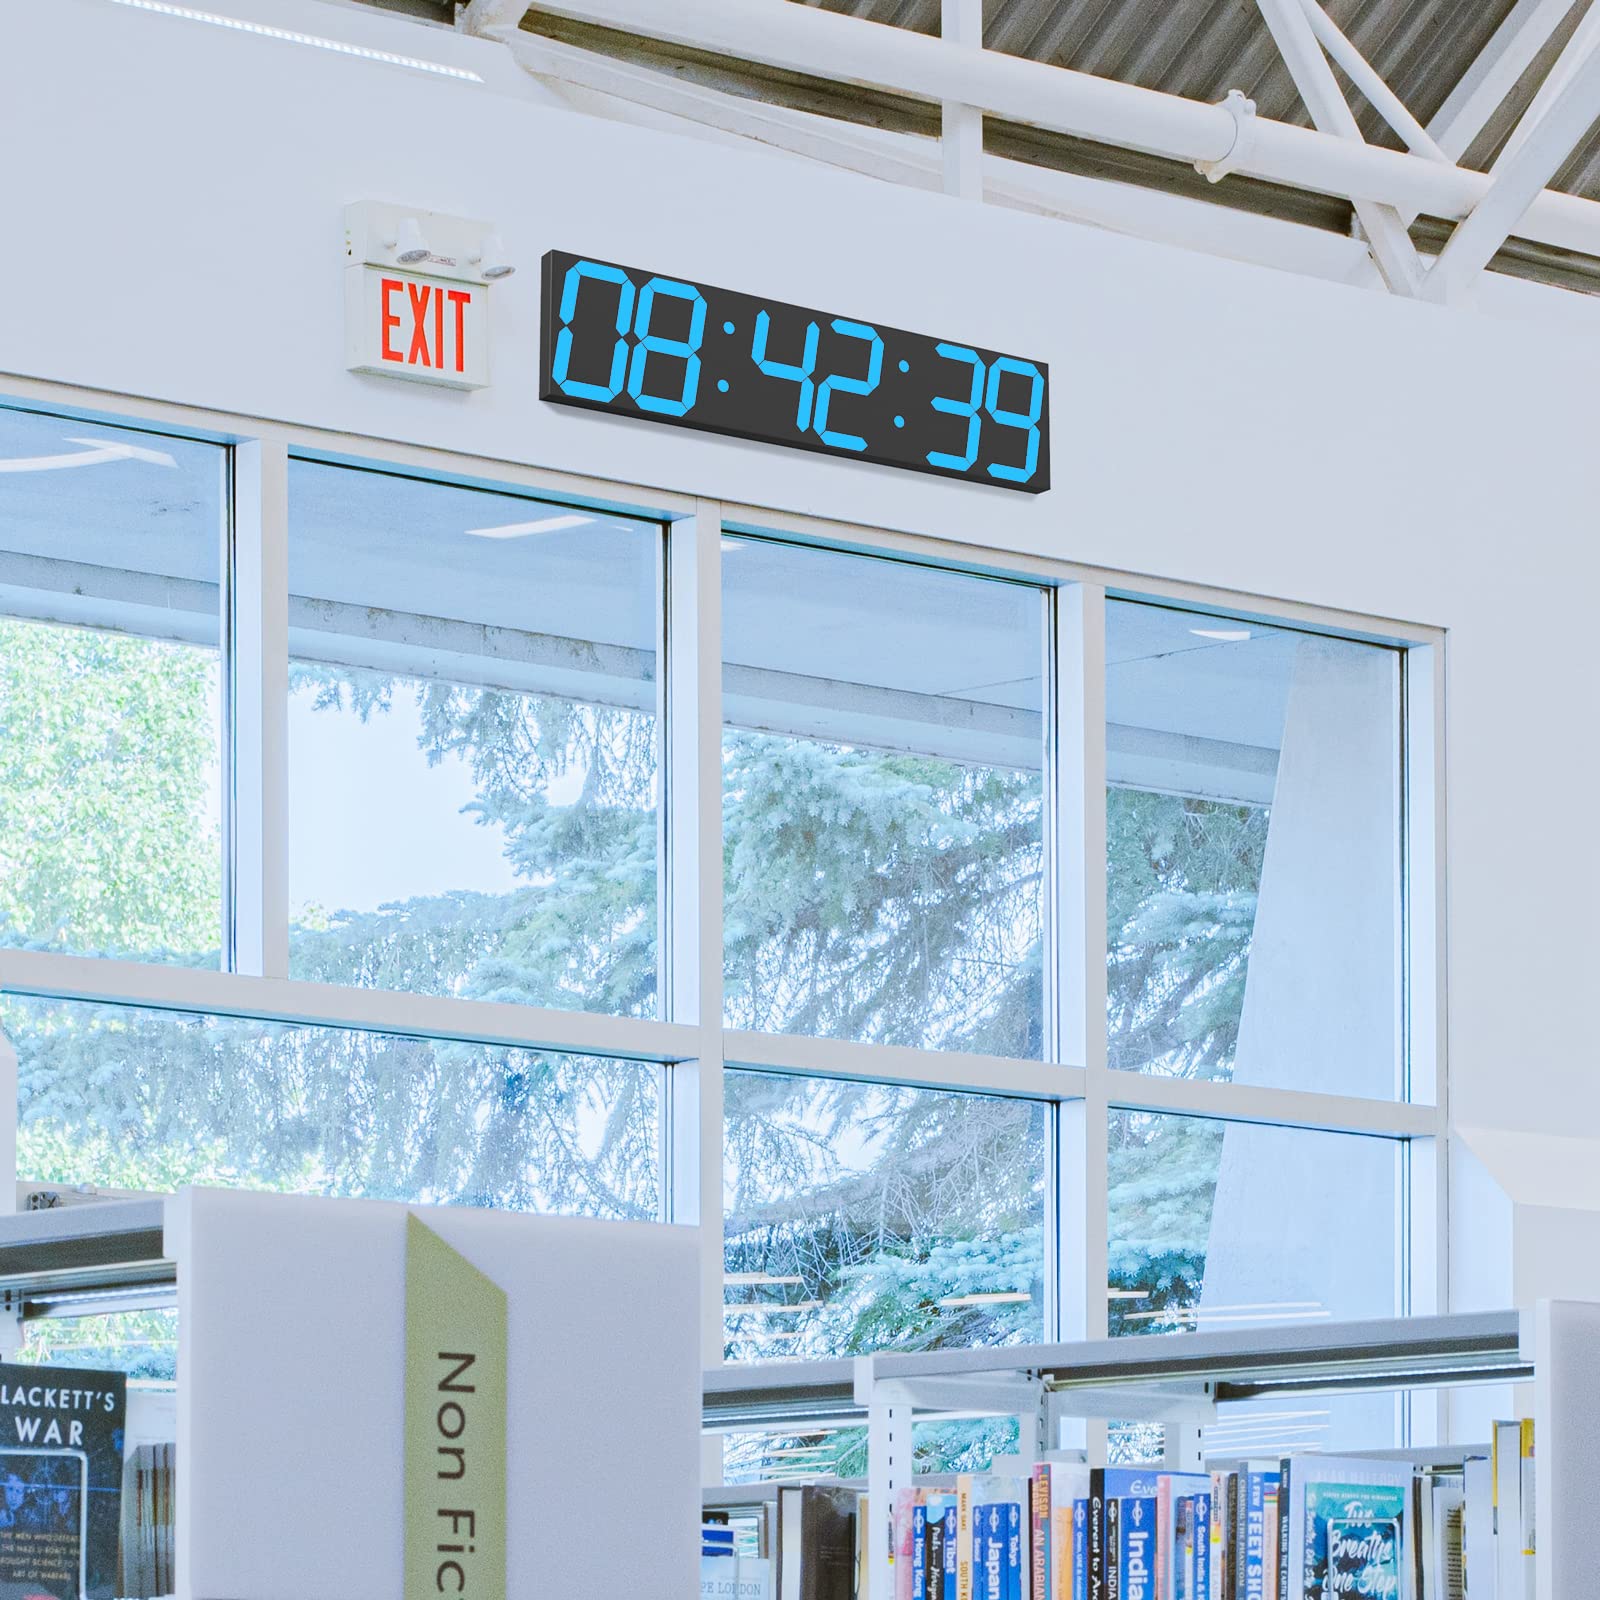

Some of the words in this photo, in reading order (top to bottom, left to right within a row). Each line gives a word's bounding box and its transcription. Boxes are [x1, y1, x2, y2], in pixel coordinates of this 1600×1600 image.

[381, 278, 471, 372] EXIT
[551, 260, 1046, 484] 08:42:39
[14, 1416, 84, 1446] WAR
[437, 1351, 476, 1480] Non
[1039, 1474, 1048, 1519] LEVISON
[1252, 1476, 1260, 1484] A
[1252, 1485, 1260, 1507] FEW
[1034, 1529, 1044, 1547] AN
[1092, 1496, 1101, 1554] Everest
[1197, 1526, 1206, 1556] South
[1248, 1511, 1262, 1559] FEET
[436, 1509, 476, 1599] Fic
[913, 1537, 923, 1567] Hong
[946, 1537, 956, 1574] Tibet
[1009, 1535, 1018, 1567] Tokyo
[1092, 1557, 1101, 1572] to
[1129, 1532, 1149, 1600] India
[913, 1569, 923, 1598] Kong
[960, 1561, 968, 1590] SOUTH
[986, 1537, 1003, 1600] Japan
[1034, 1550, 1044, 1600] ARABIAN
[1108, 1566, 1117, 1600] INDIA
[1197, 1557, 1206, 1582] India
